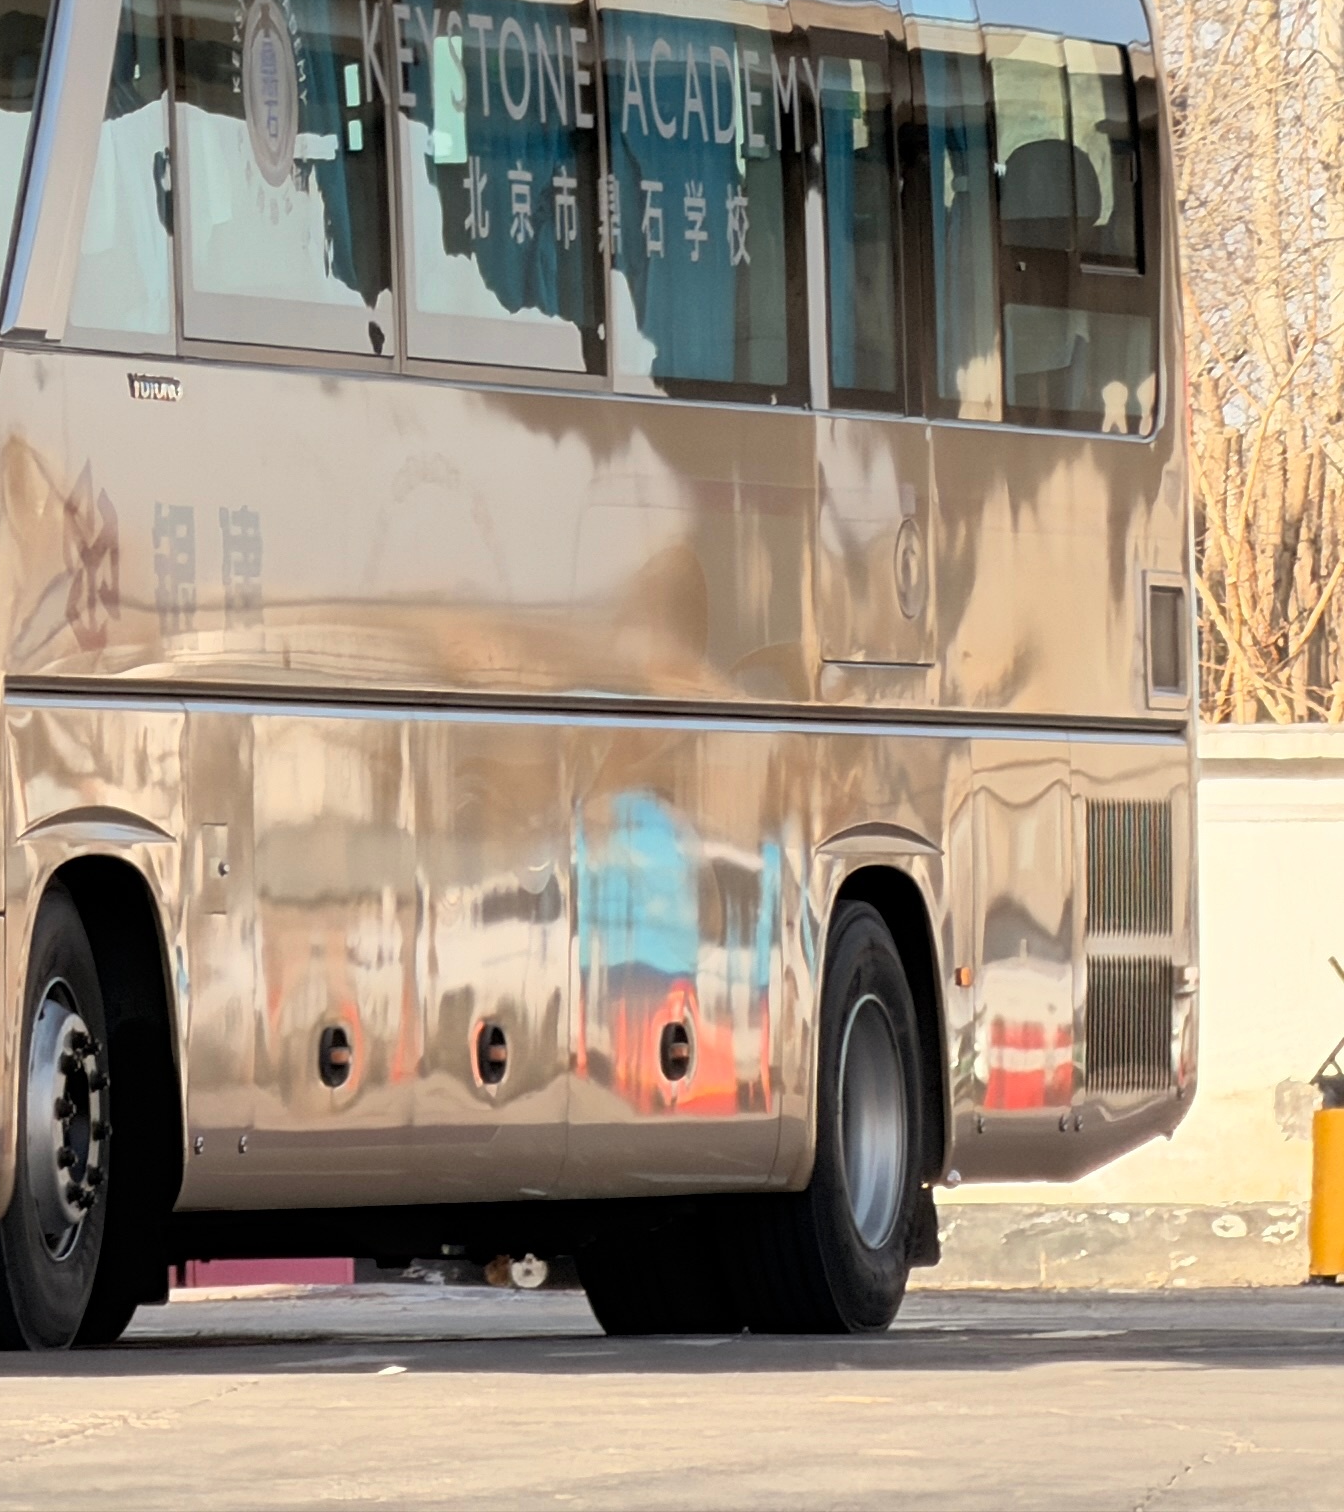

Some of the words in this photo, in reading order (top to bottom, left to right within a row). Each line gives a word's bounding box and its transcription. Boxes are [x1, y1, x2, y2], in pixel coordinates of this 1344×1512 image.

[621, 33, 825, 154] ACADEMY
[462, 153, 752, 267] 北京市鼎石学校
